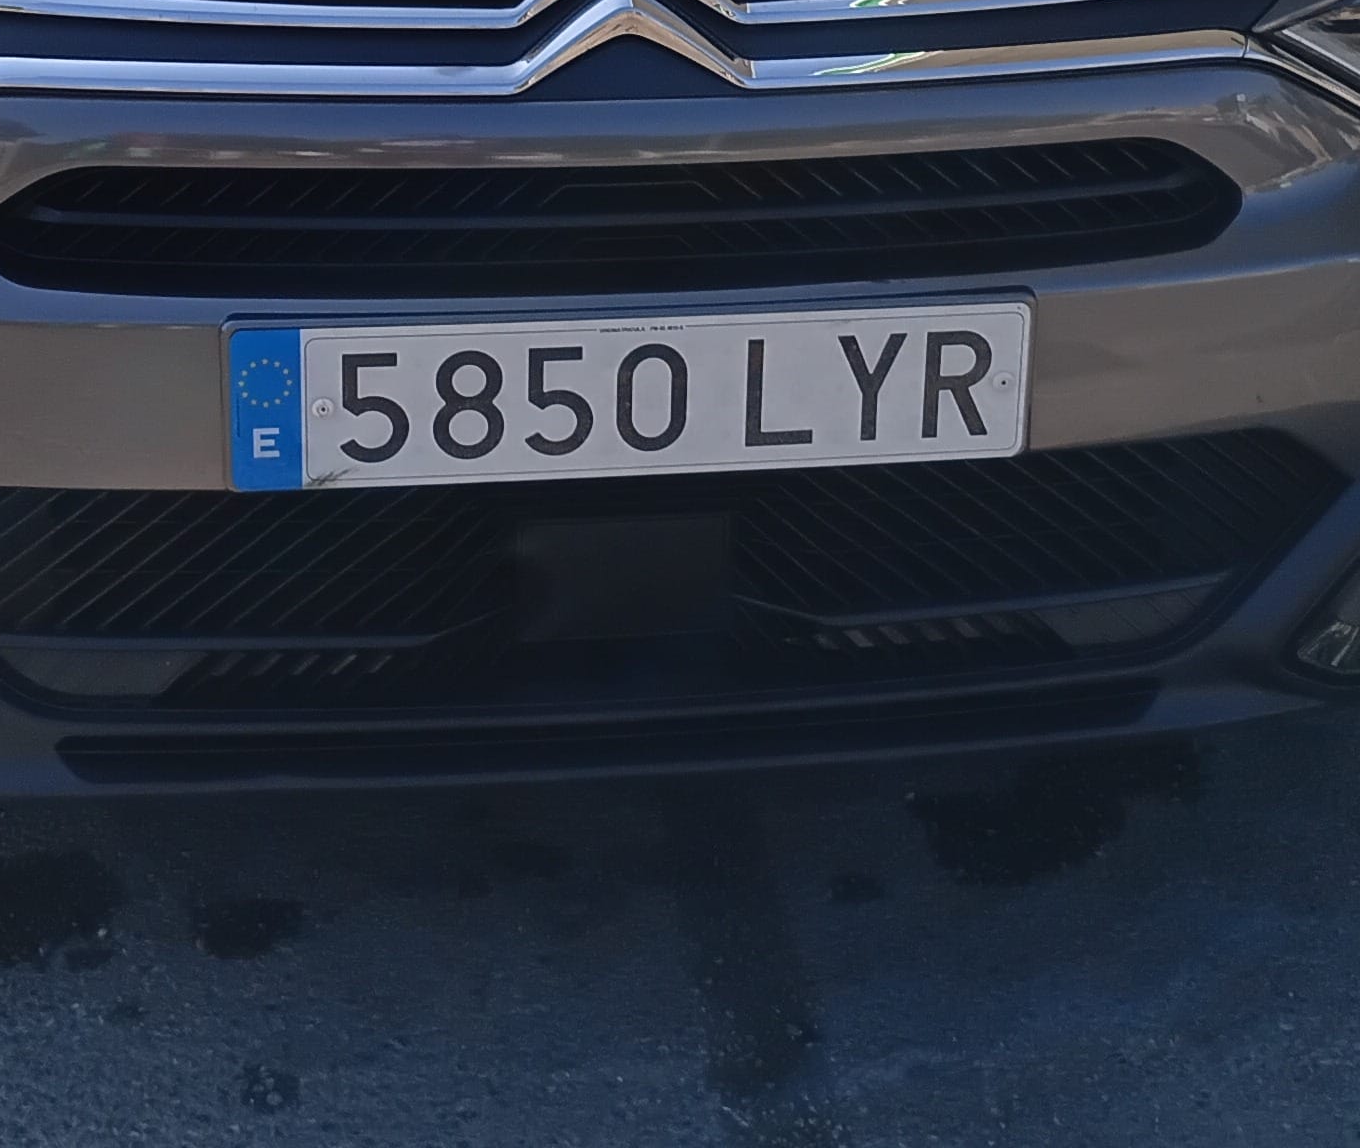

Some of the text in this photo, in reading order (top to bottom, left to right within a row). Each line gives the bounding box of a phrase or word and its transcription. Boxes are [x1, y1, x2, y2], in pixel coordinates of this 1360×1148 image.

[340, 331, 992, 463] 5850 LYR
[252, 426, 281, 458] E
